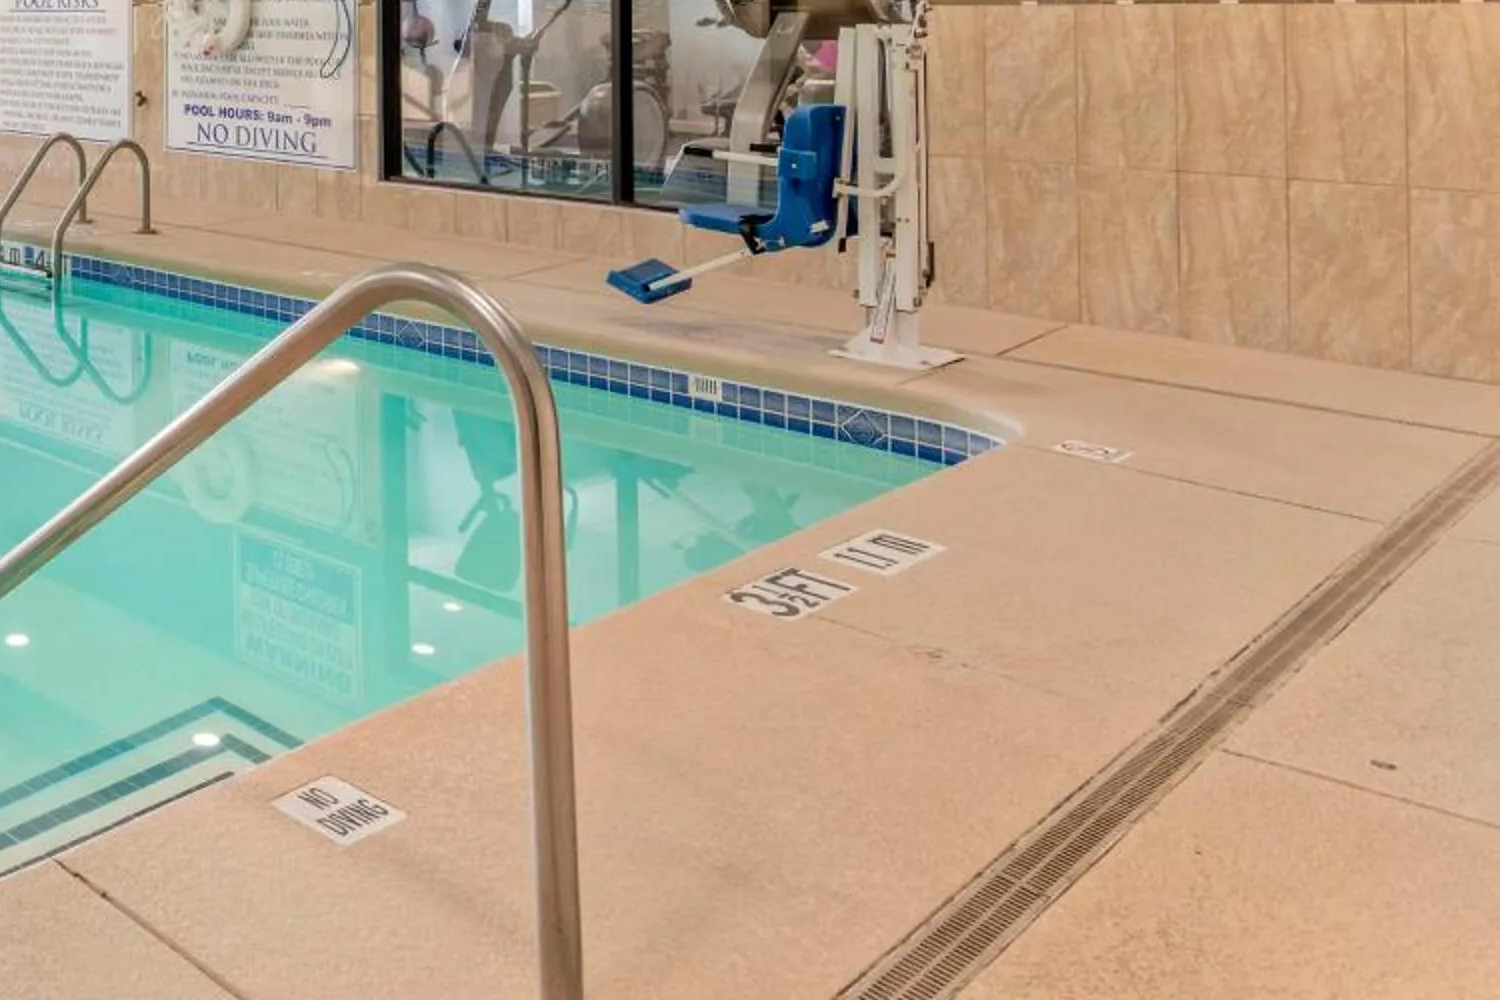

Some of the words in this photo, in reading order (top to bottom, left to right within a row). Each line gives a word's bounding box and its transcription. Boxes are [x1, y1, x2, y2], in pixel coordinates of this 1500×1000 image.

[184, 103, 215, 117] POOL
[218, 106, 264, 121] HOURS:
[303, 113, 331, 128] 9pm
[197, 122, 229, 144] NO
[235, 125, 317, 153] DIVING
[296, 787, 339, 811] NO
[316, 798, 390, 837] DIVING
